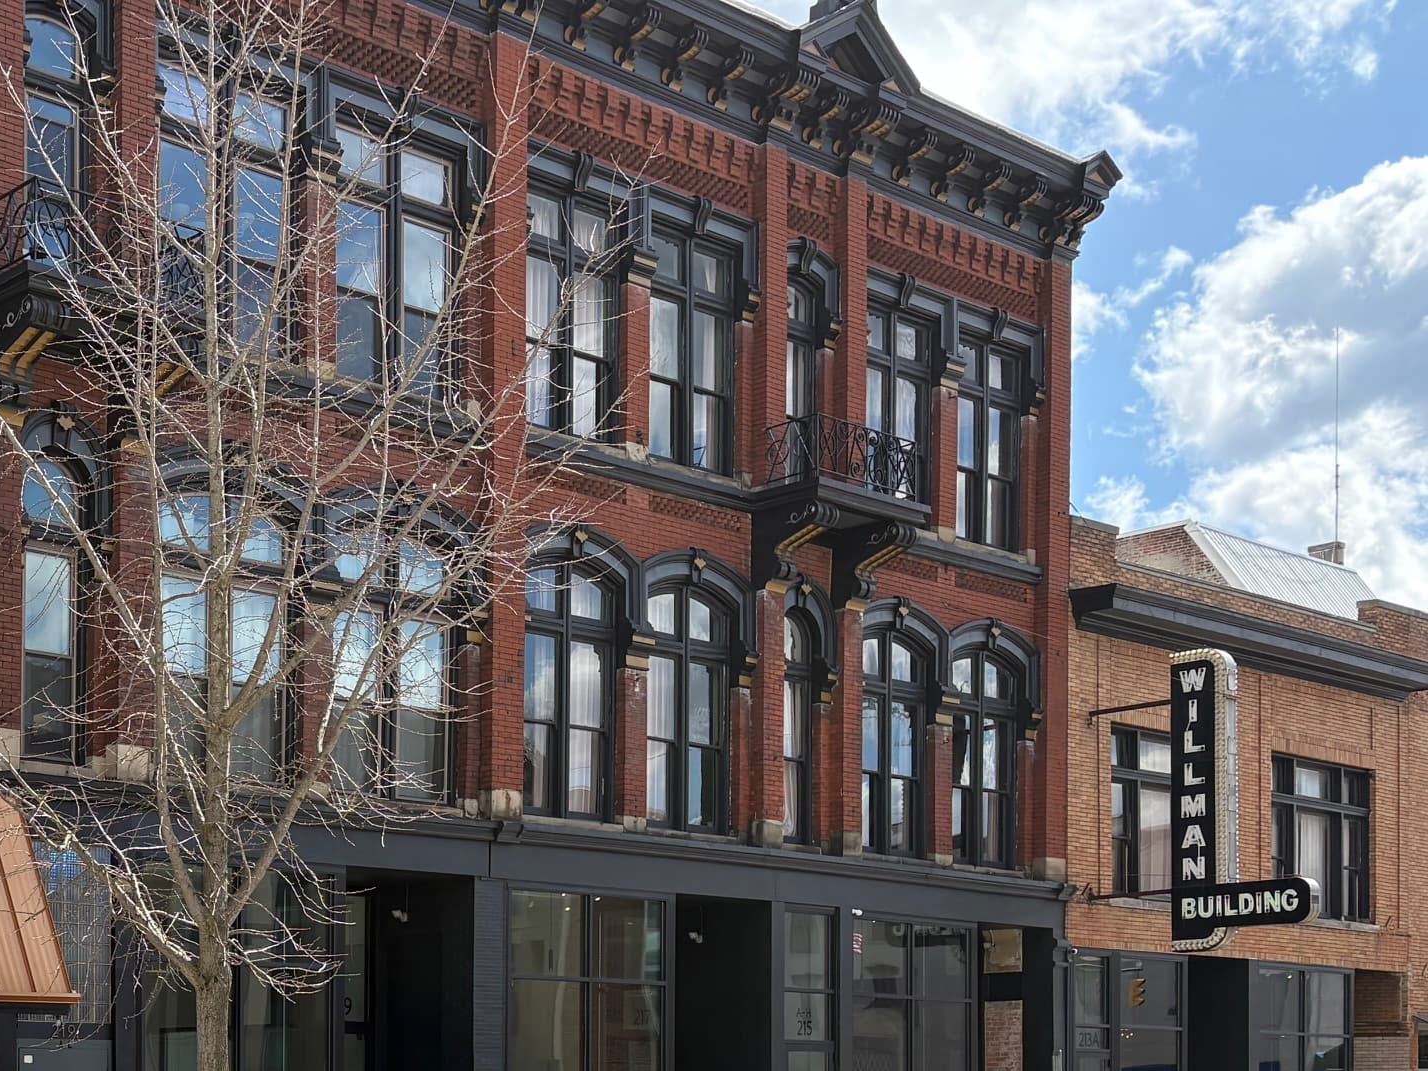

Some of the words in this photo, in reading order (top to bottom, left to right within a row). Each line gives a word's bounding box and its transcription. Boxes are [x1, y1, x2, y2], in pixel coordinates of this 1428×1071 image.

[1178, 666, 1207, 882] WILLMAN
[1182, 888, 1300, 921] BUILDING
[52, 1023, 76, 1037] 219
[797, 1020, 813, 1036] 215
